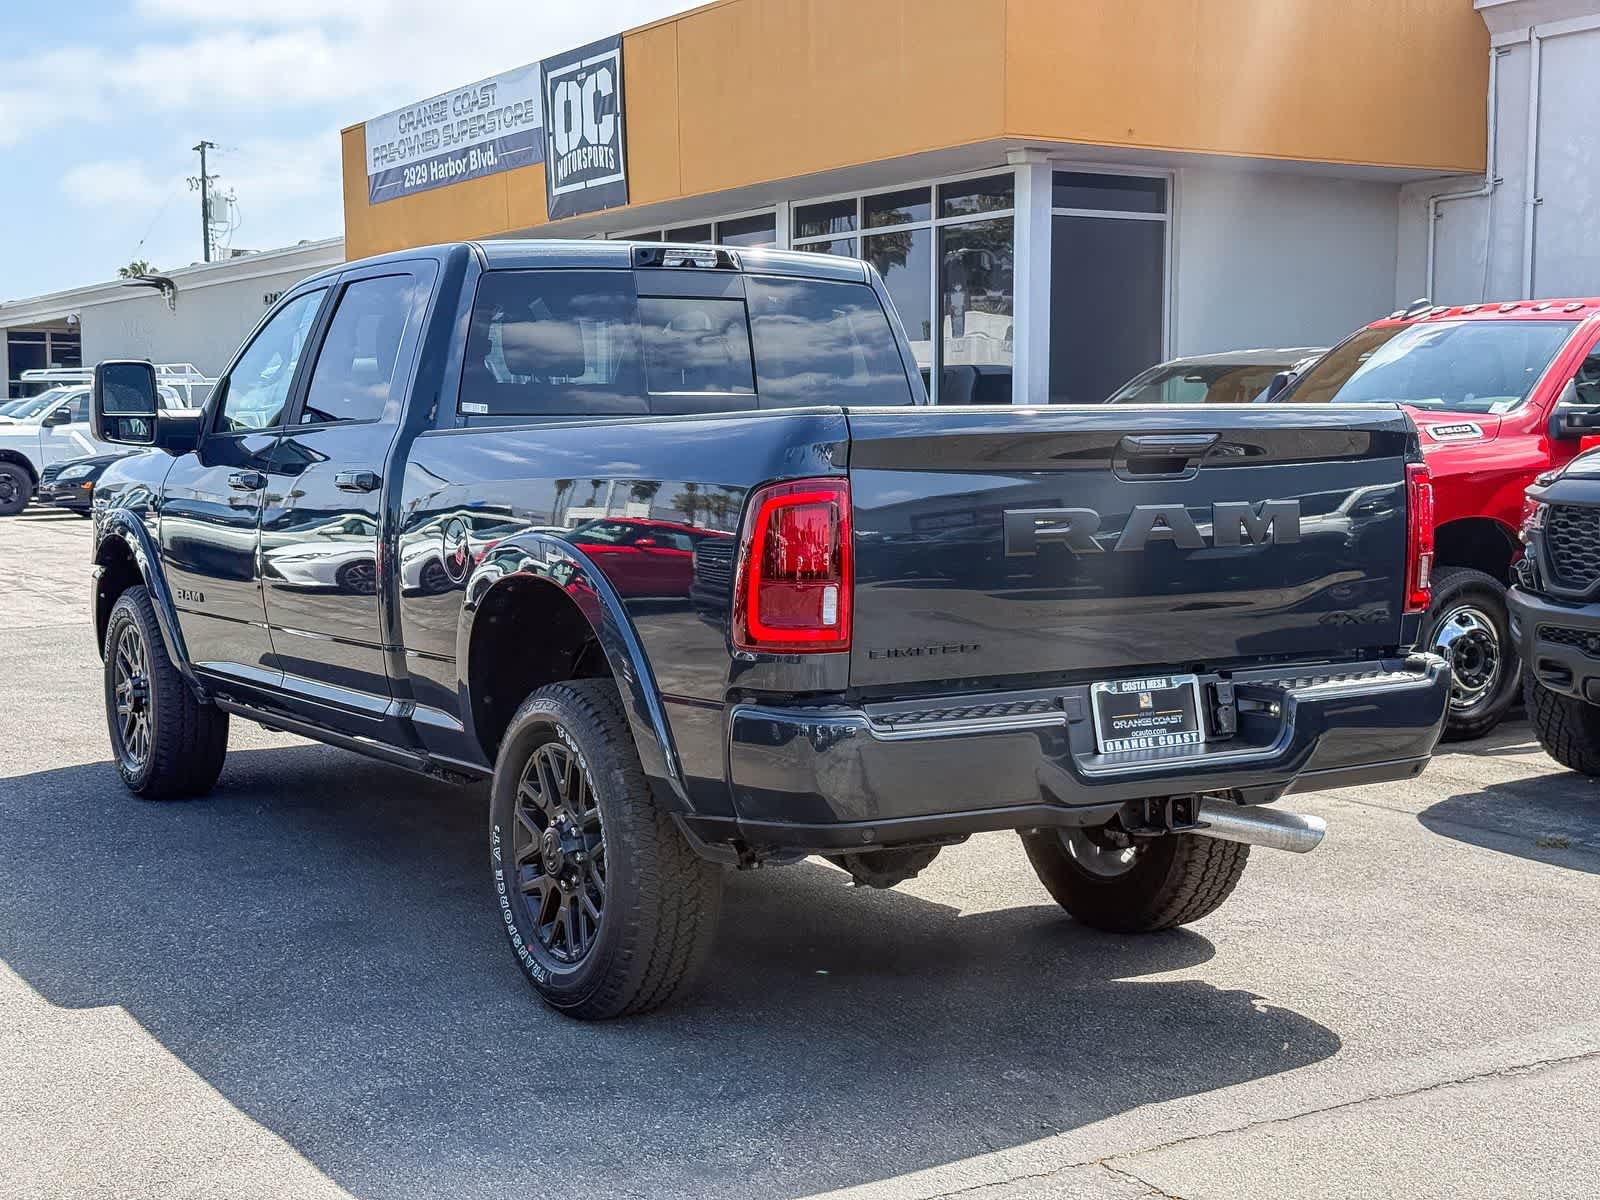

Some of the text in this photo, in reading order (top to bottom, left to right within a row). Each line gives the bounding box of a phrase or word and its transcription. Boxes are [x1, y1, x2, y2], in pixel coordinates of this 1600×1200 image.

[398, 82, 498, 135] ORANGE COAST
[554, 67, 615, 154] OC
[372, 98, 534, 168] PRE-OWNED SUPERSTORE
[403, 144, 498, 188] 2929 Harbor Blvd.
[557, 146, 615, 181] MOTORSPORTS
[1003, 499, 1300, 558] RAM
[867, 643, 981, 661] LIMITED
[1121, 678, 1167, 692] COSTA MESA
[1113, 718, 1153, 729] ORANGE
[1152, 714, 1184, 727] COAST
[1131, 727, 1167, 737] ocauto.com
[1106, 732, 1198, 752] ORANGE COAST
